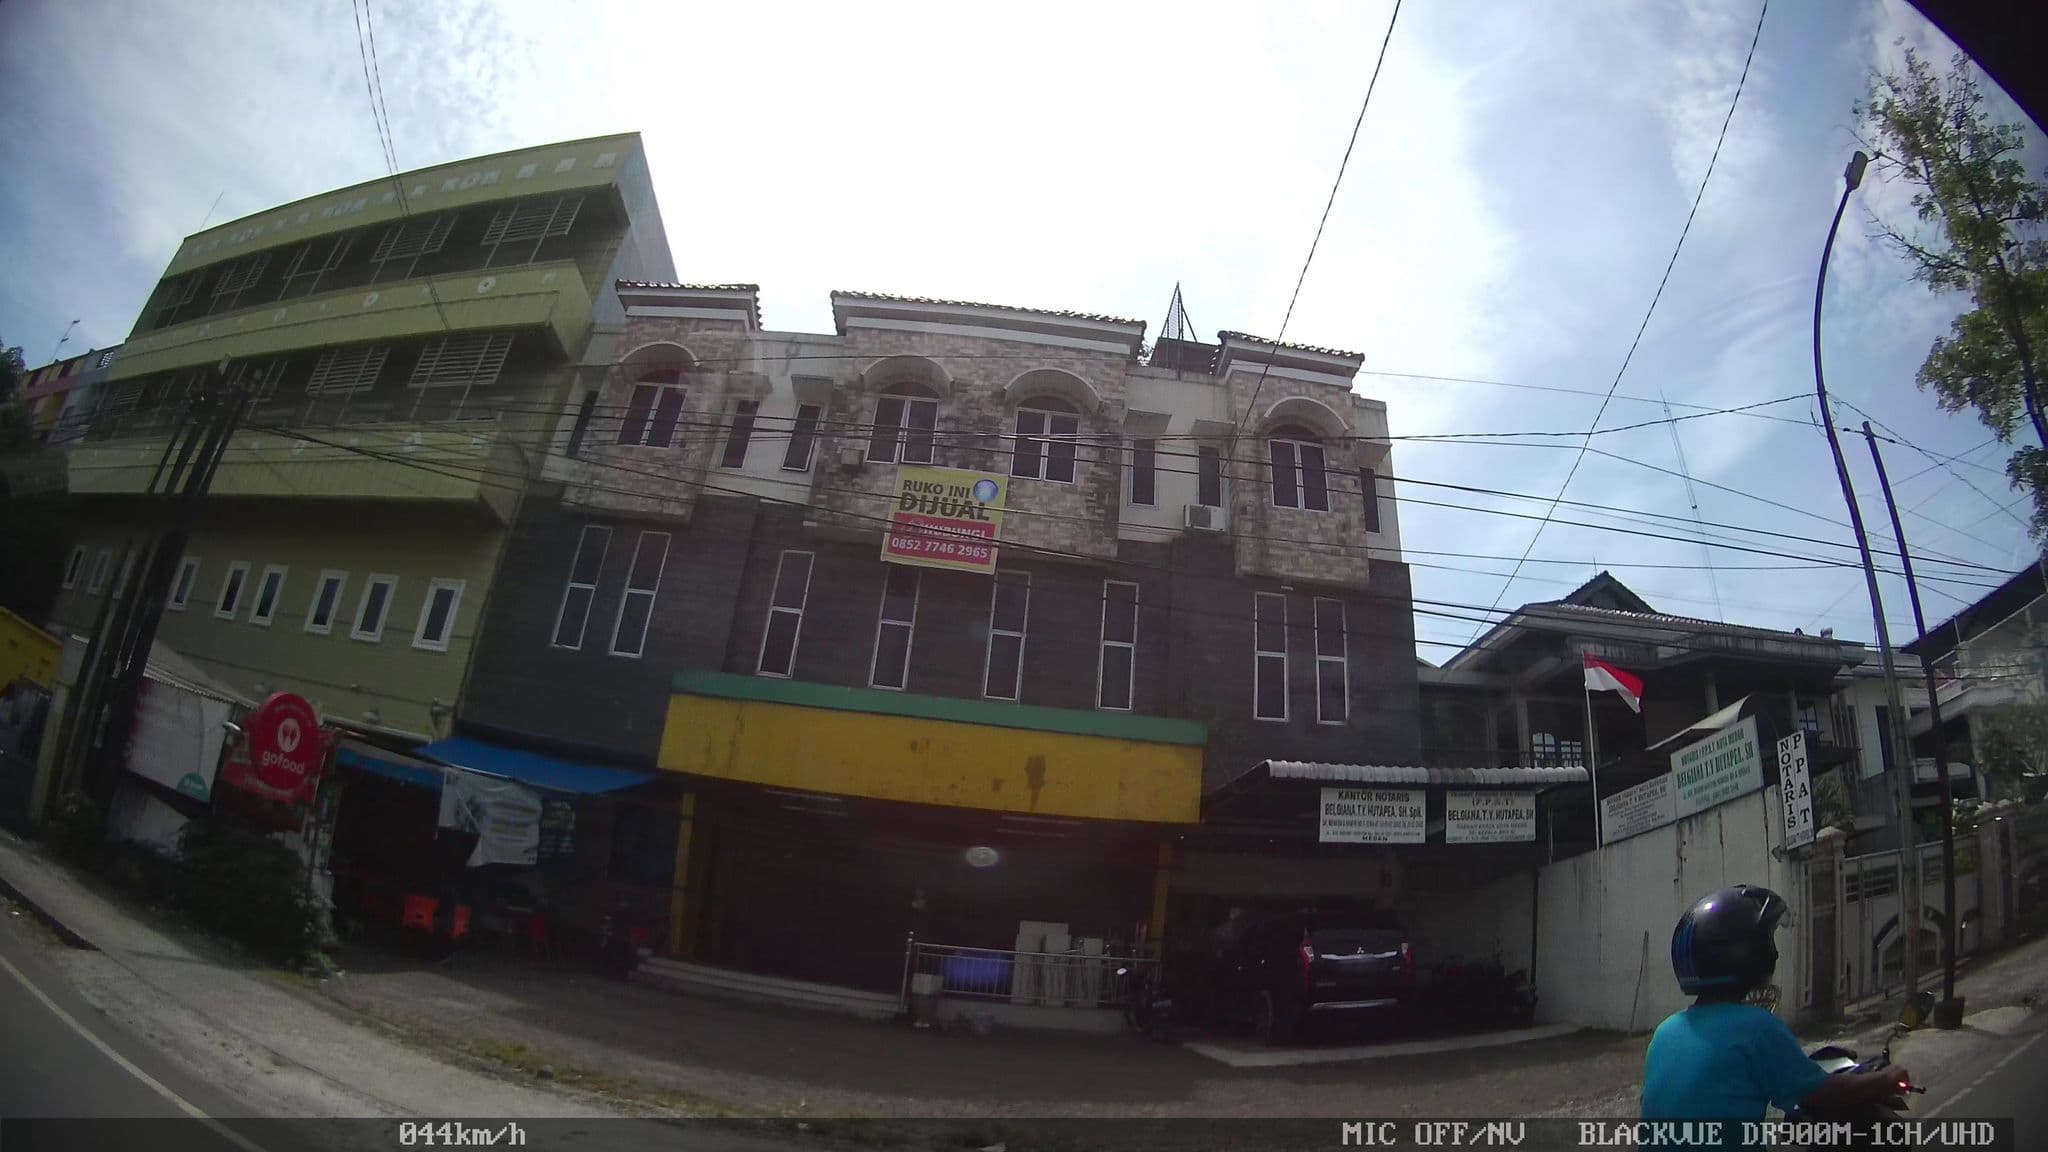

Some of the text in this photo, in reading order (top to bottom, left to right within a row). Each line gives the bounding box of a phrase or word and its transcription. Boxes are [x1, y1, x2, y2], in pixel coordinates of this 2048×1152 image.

[903, 480, 970, 499] RUKO INI
[899, 492, 989, 520] DIJUAL
[892, 538, 988, 558] 0852 7746 2965
[263, 751, 304, 774] gofood
[1780, 739, 1797, 829] NOTARIS
[1338, 790, 1410, 803] KANTOR NOTARIS
